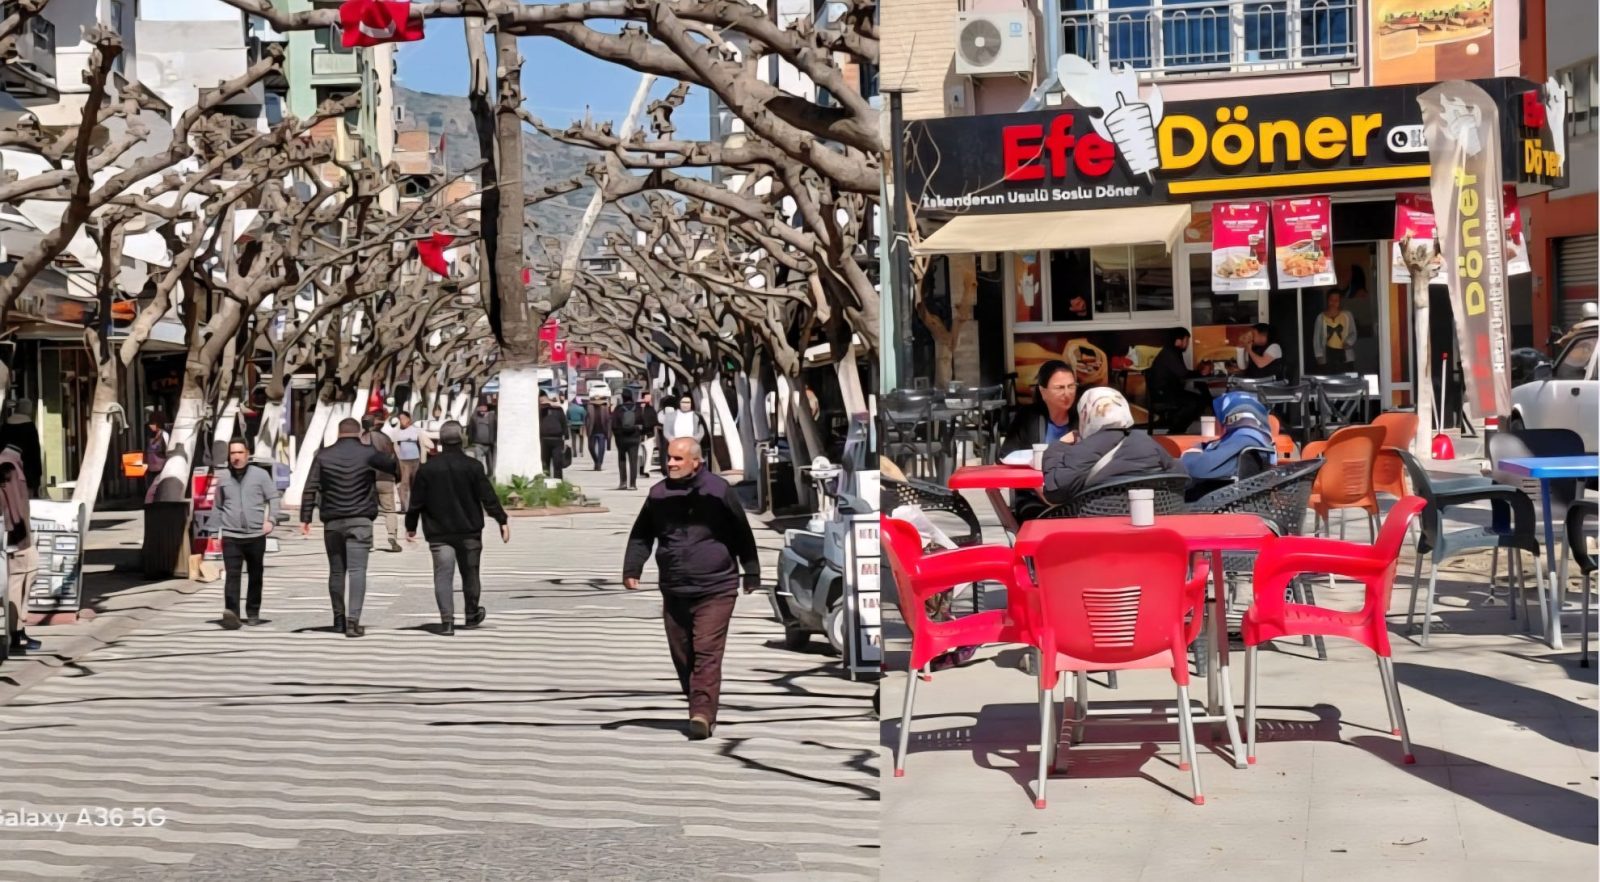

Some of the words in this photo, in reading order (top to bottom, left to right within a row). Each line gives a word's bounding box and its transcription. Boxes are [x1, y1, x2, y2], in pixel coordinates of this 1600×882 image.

[1003, 114, 1116, 181] Efe
[1158, 105, 1382, 170] Döner
[1008, 189, 1049, 204] Usulü
[1052, 186, 1093, 201] Soslu
[1096, 184, 1140, 199] Döner
[1453, 166, 1486, 316] Döner
